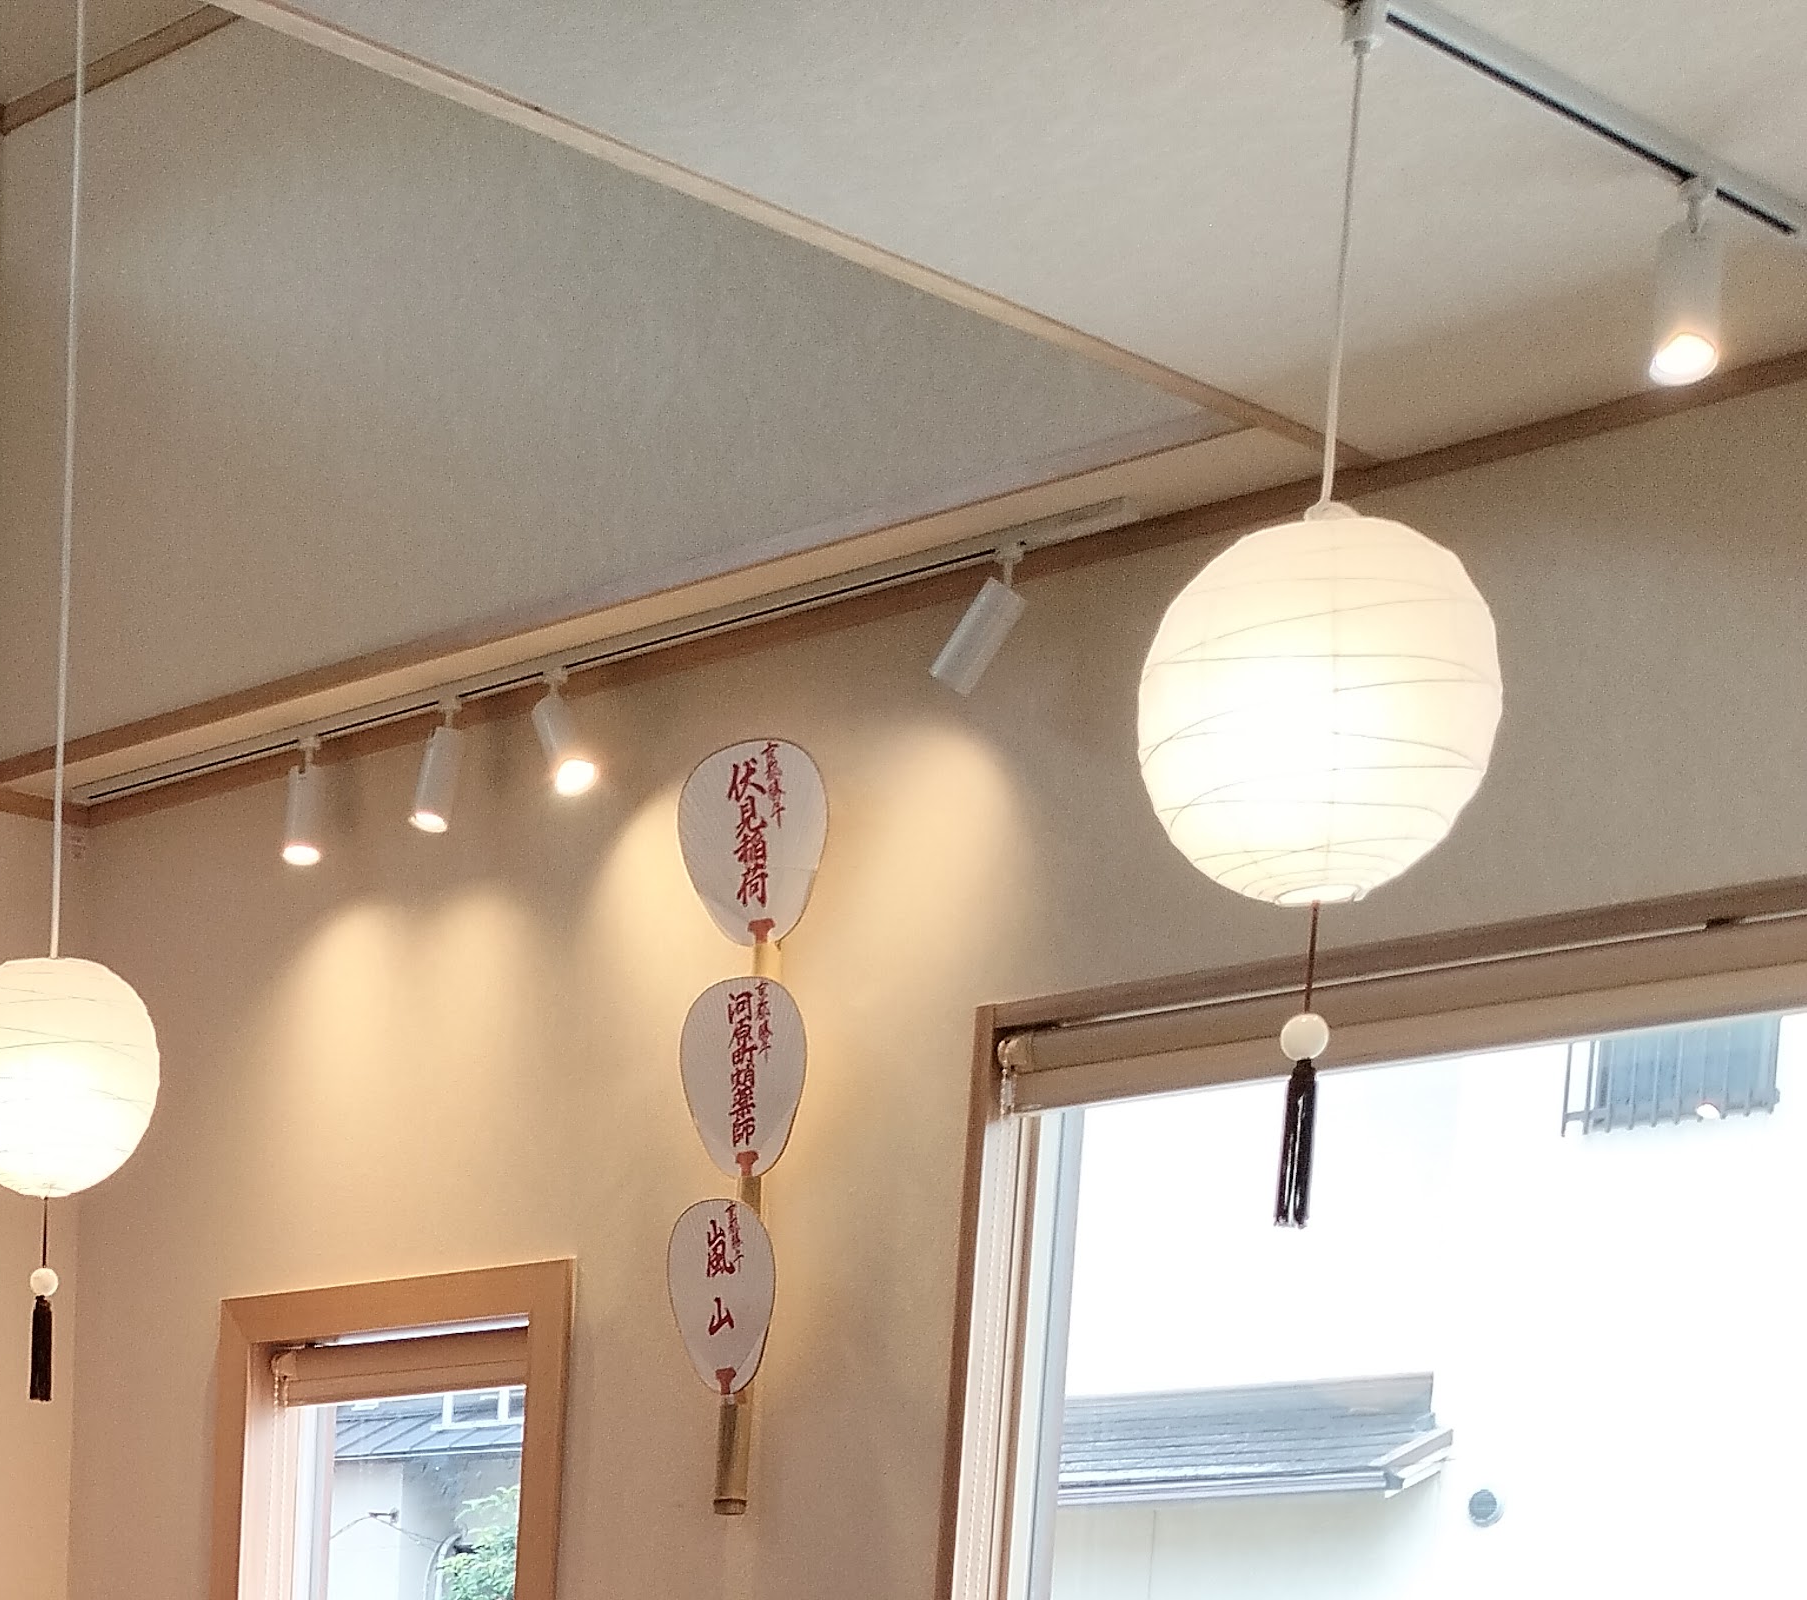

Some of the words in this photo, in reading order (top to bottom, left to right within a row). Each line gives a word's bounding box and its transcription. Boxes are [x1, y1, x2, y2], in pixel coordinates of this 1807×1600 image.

[727, 757, 768, 908] 伏見稲荷
[727, 990, 758, 1147] 河原町蛸薬師
[706, 1219, 736, 1336] 嵐山
